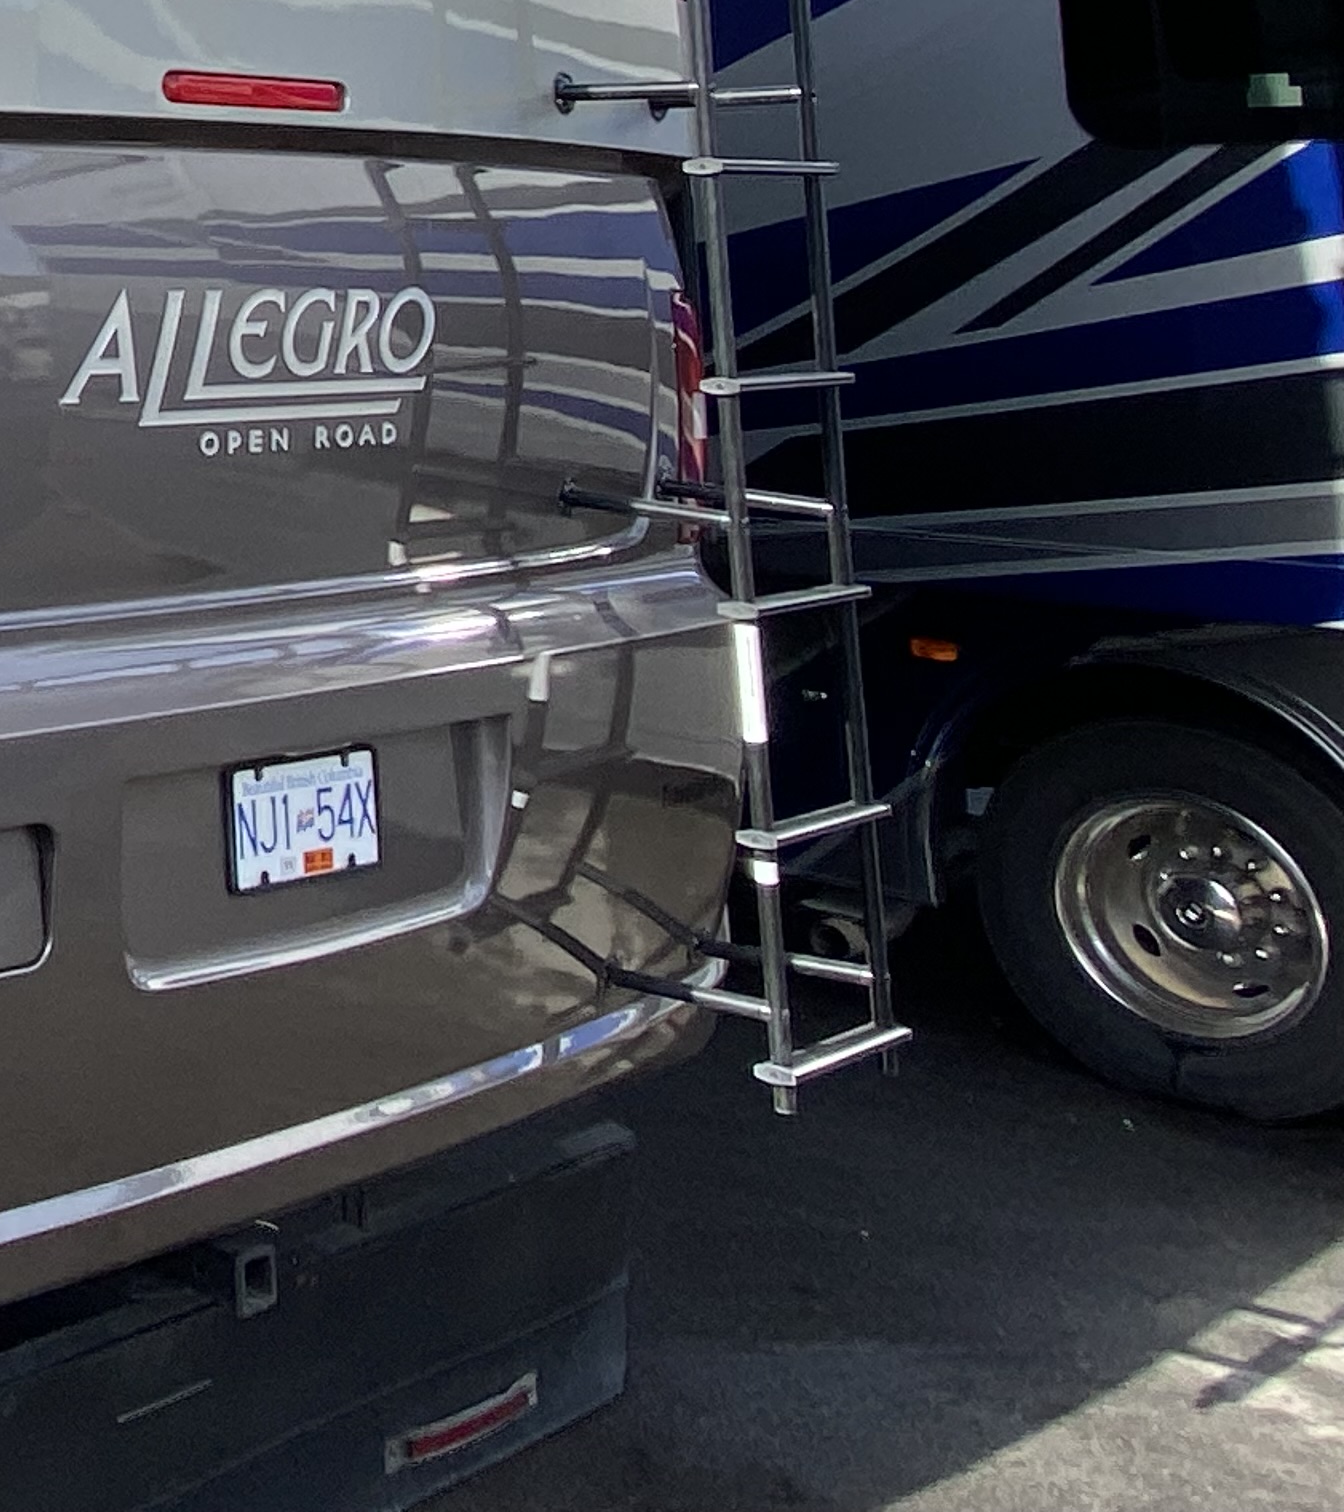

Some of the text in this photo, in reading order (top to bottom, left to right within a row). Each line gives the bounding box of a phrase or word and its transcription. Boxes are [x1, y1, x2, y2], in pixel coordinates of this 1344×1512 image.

[58, 286, 437, 427] ALLEGRO
[199, 421, 398, 456] OPEN ROAD
[238, 780, 375, 859] NJ1 54X
